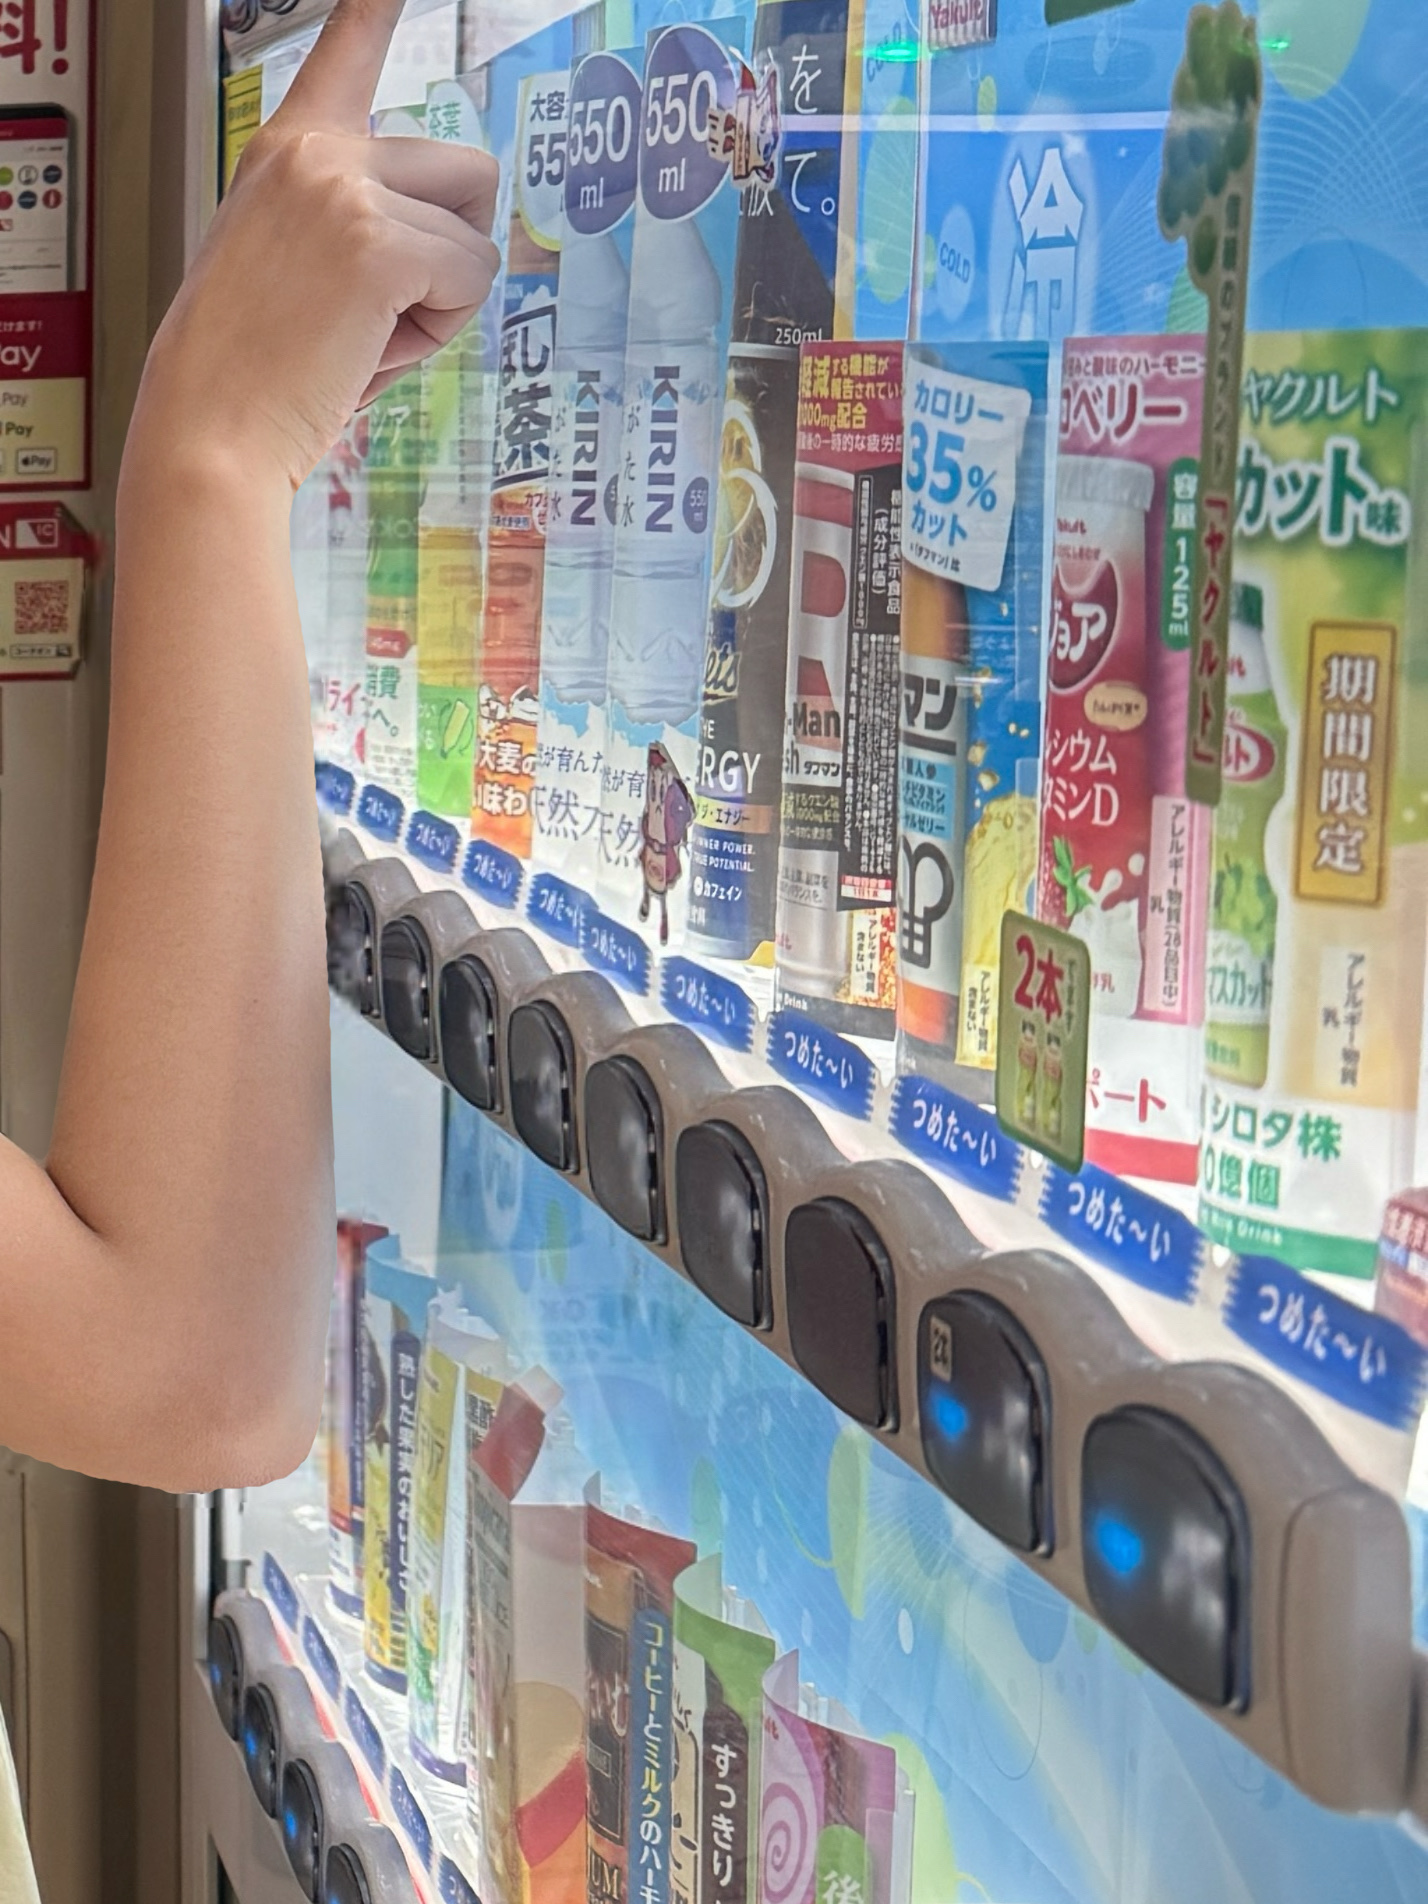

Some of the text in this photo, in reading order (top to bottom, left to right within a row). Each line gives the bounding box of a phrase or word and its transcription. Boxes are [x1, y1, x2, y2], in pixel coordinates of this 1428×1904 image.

[578, 177, 605, 210] ml
[658, 158, 686, 194] ml
[5, 421, 34, 438] Pay
[914, 379, 1005, 424] カロリー
[569, 369, 601, 526] KIRIN
[644, 364, 681, 533] KIRIN
[906, 420, 998, 513] 35%
[910, 500, 968, 547] カット
[1313, 651, 1377, 874] 期間限定
[1012, 932, 1066, 1023] 2本
[782, 1027, 856, 1091] つめた〜い
[910, 1100, 999, 1171] つめた〜い
[1067, 1180, 1173, 1265] つめた〜い
[1256, 1281, 1388, 1381] つめた〜い
[710, 1742, 741, 1888] すっきり
